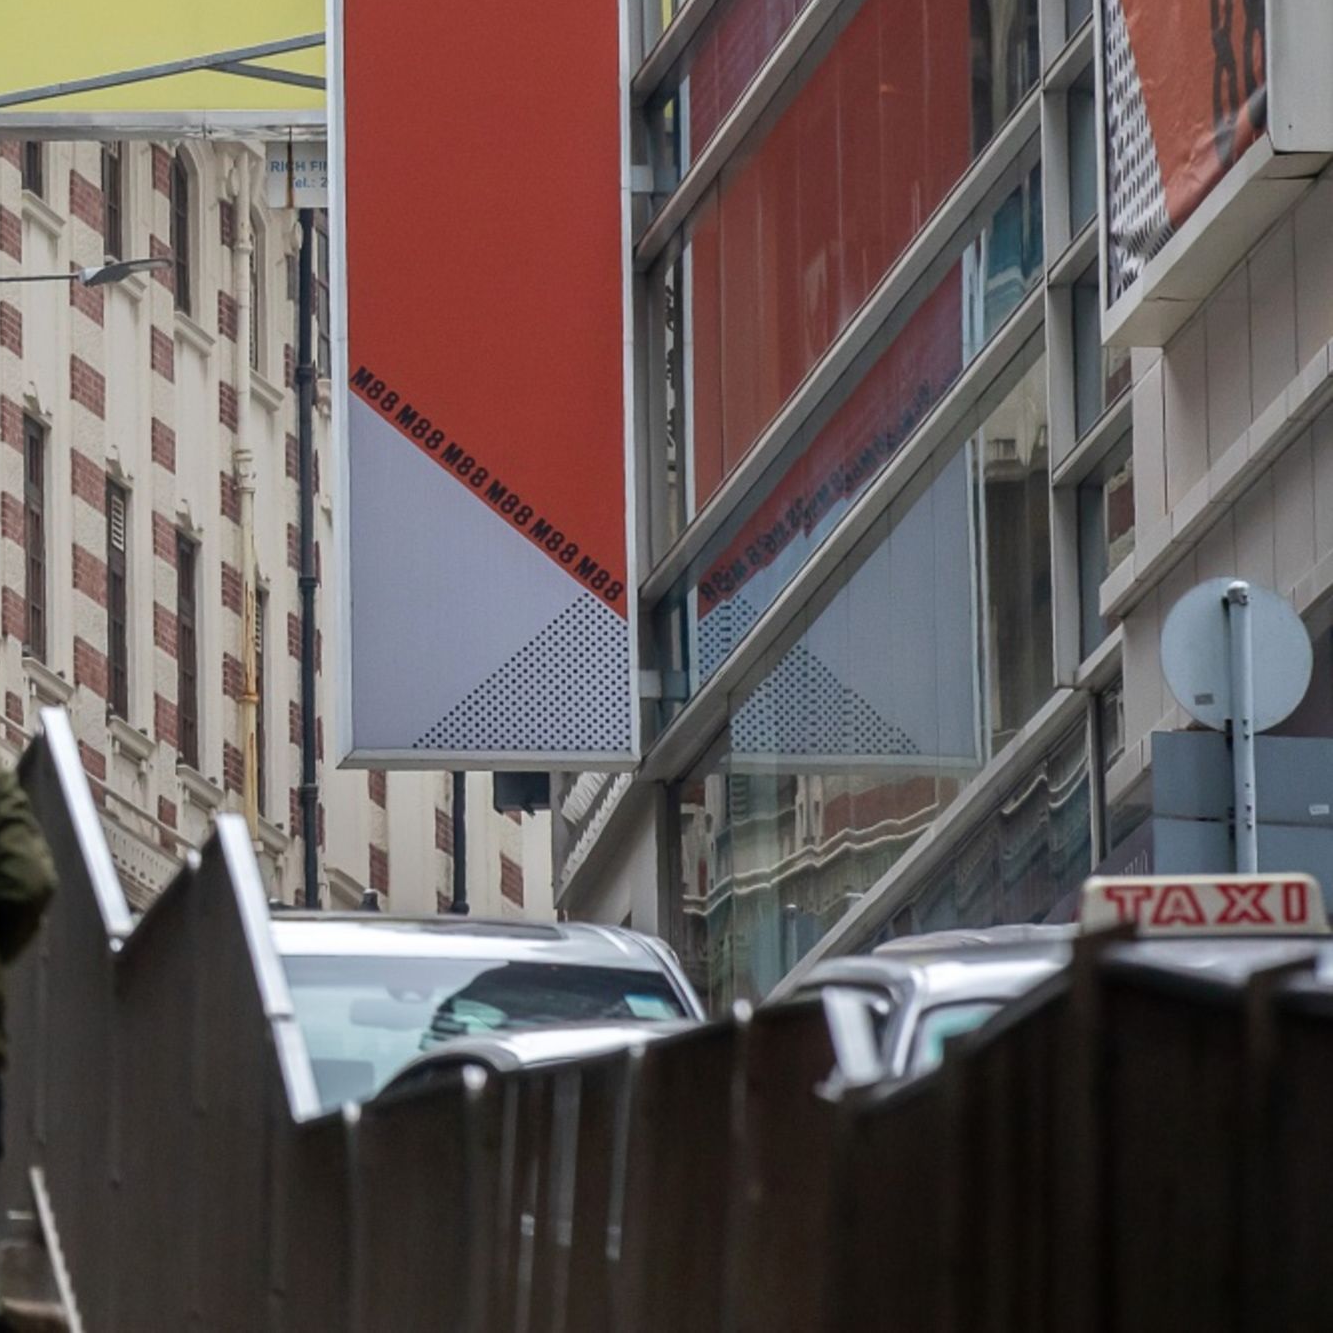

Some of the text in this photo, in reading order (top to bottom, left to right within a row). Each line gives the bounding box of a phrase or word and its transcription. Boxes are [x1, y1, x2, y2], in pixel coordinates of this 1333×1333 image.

[350, 366, 624, 603] M88 M88 M88 M88 M88 M88
[1104, 882, 1308, 926] TAXI
